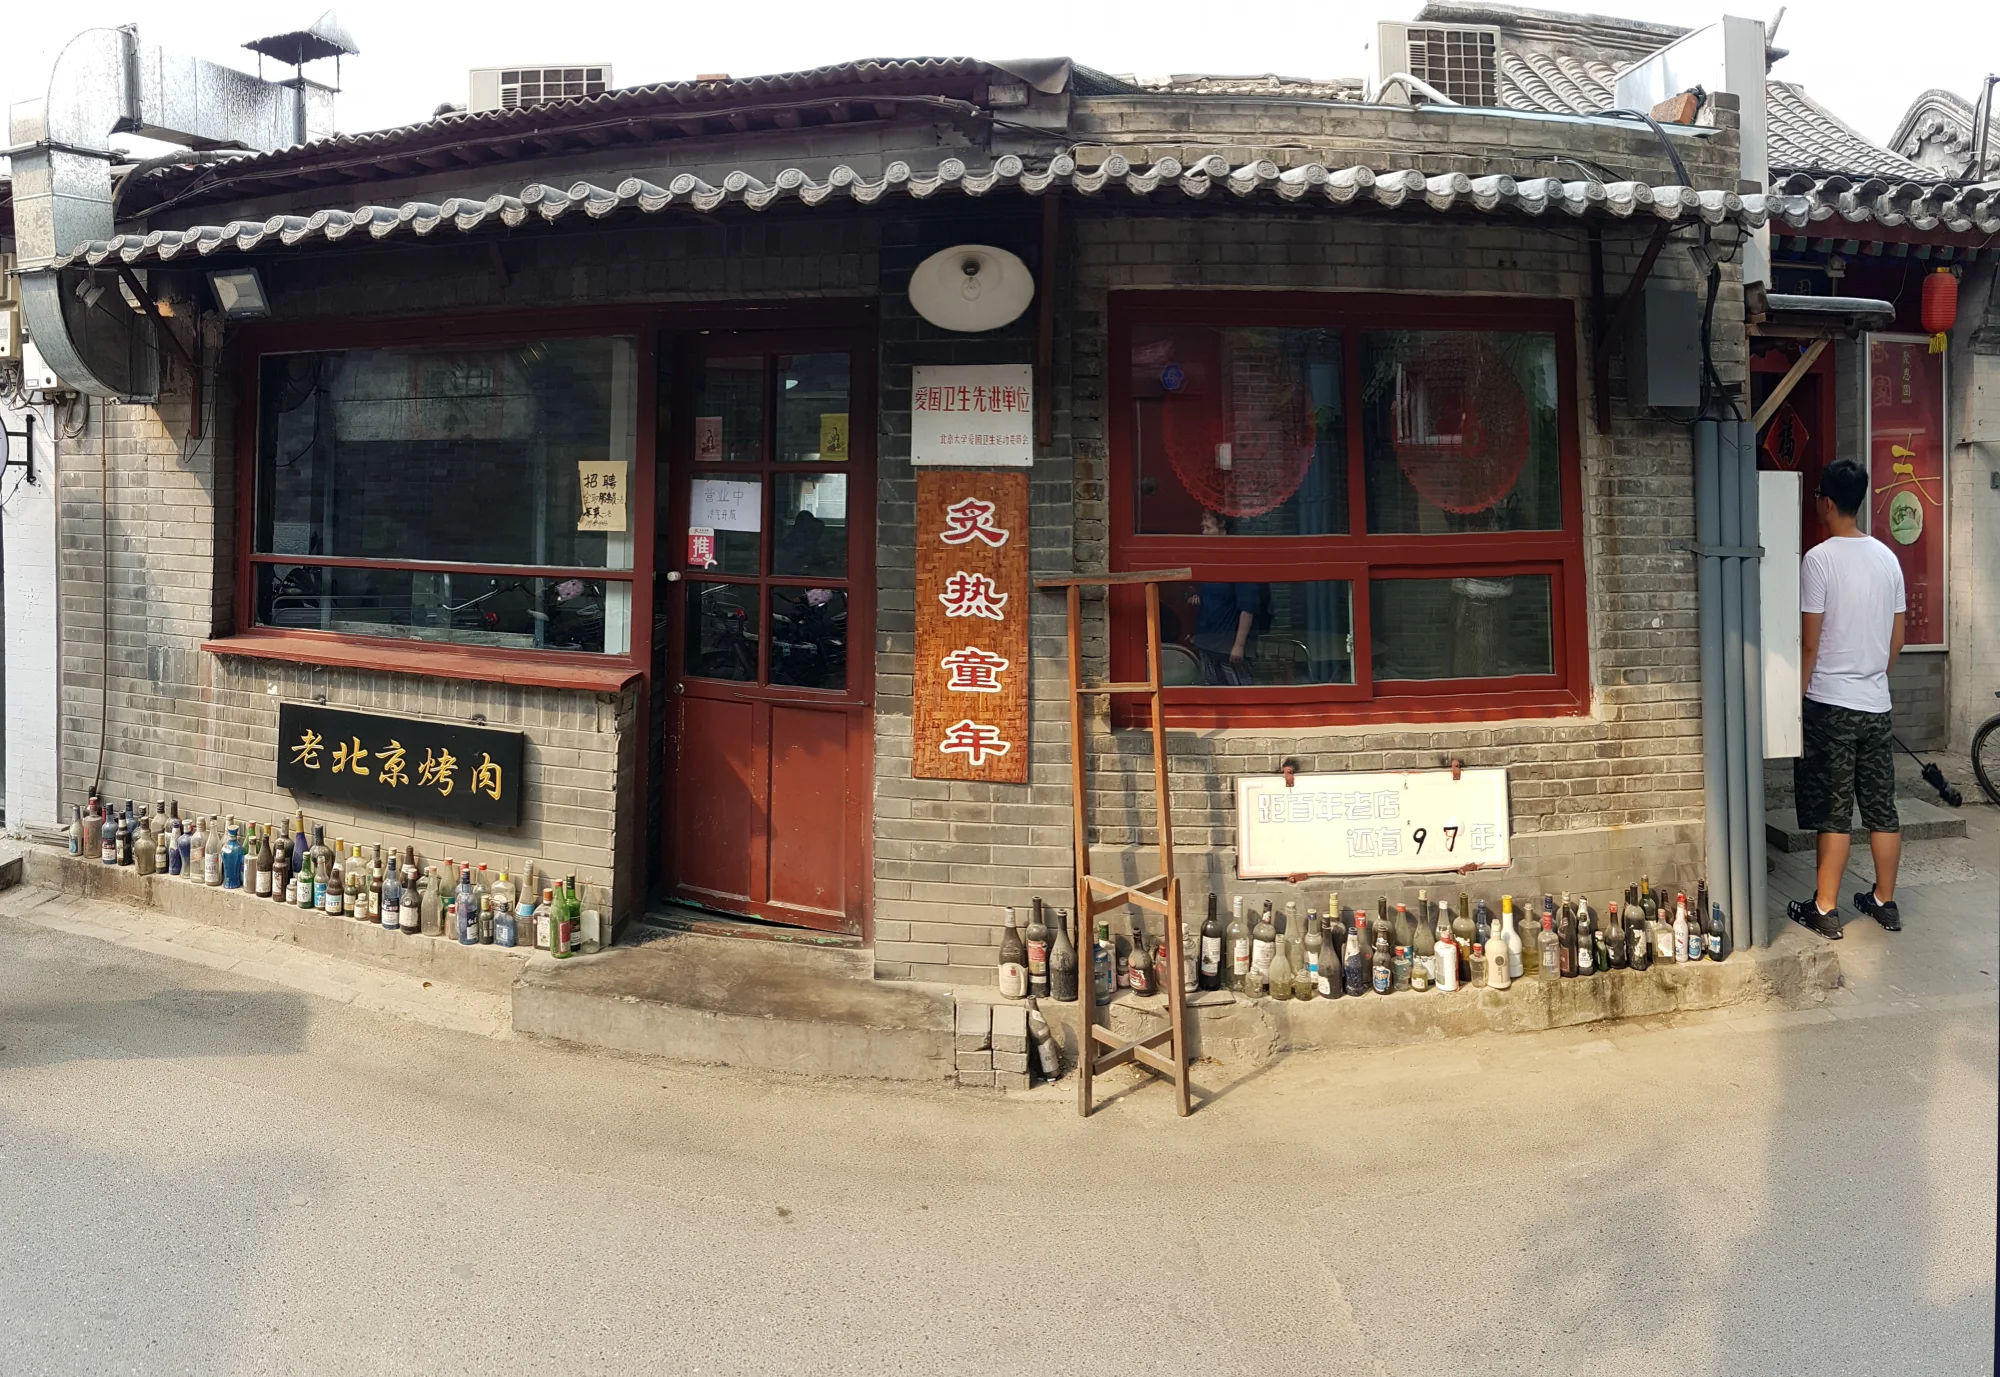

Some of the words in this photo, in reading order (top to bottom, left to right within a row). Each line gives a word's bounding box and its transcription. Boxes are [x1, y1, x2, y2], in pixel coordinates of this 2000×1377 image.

[915, 386, 1030, 412] 爱国卫生先进单位
[940, 434, 1028, 446] 北京大学爱国卫生运动委员会
[583, 473, 617, 490] 招聘
[705, 488, 744, 506] 营业中
[707, 508, 737, 521] 冷气开放
[692, 536, 710, 558] 推
[939, 497, 1010, 766] 炙热童年
[290, 729, 502, 801] 老北京烤肉
[1258, 790, 1401, 824] 距百年老店
